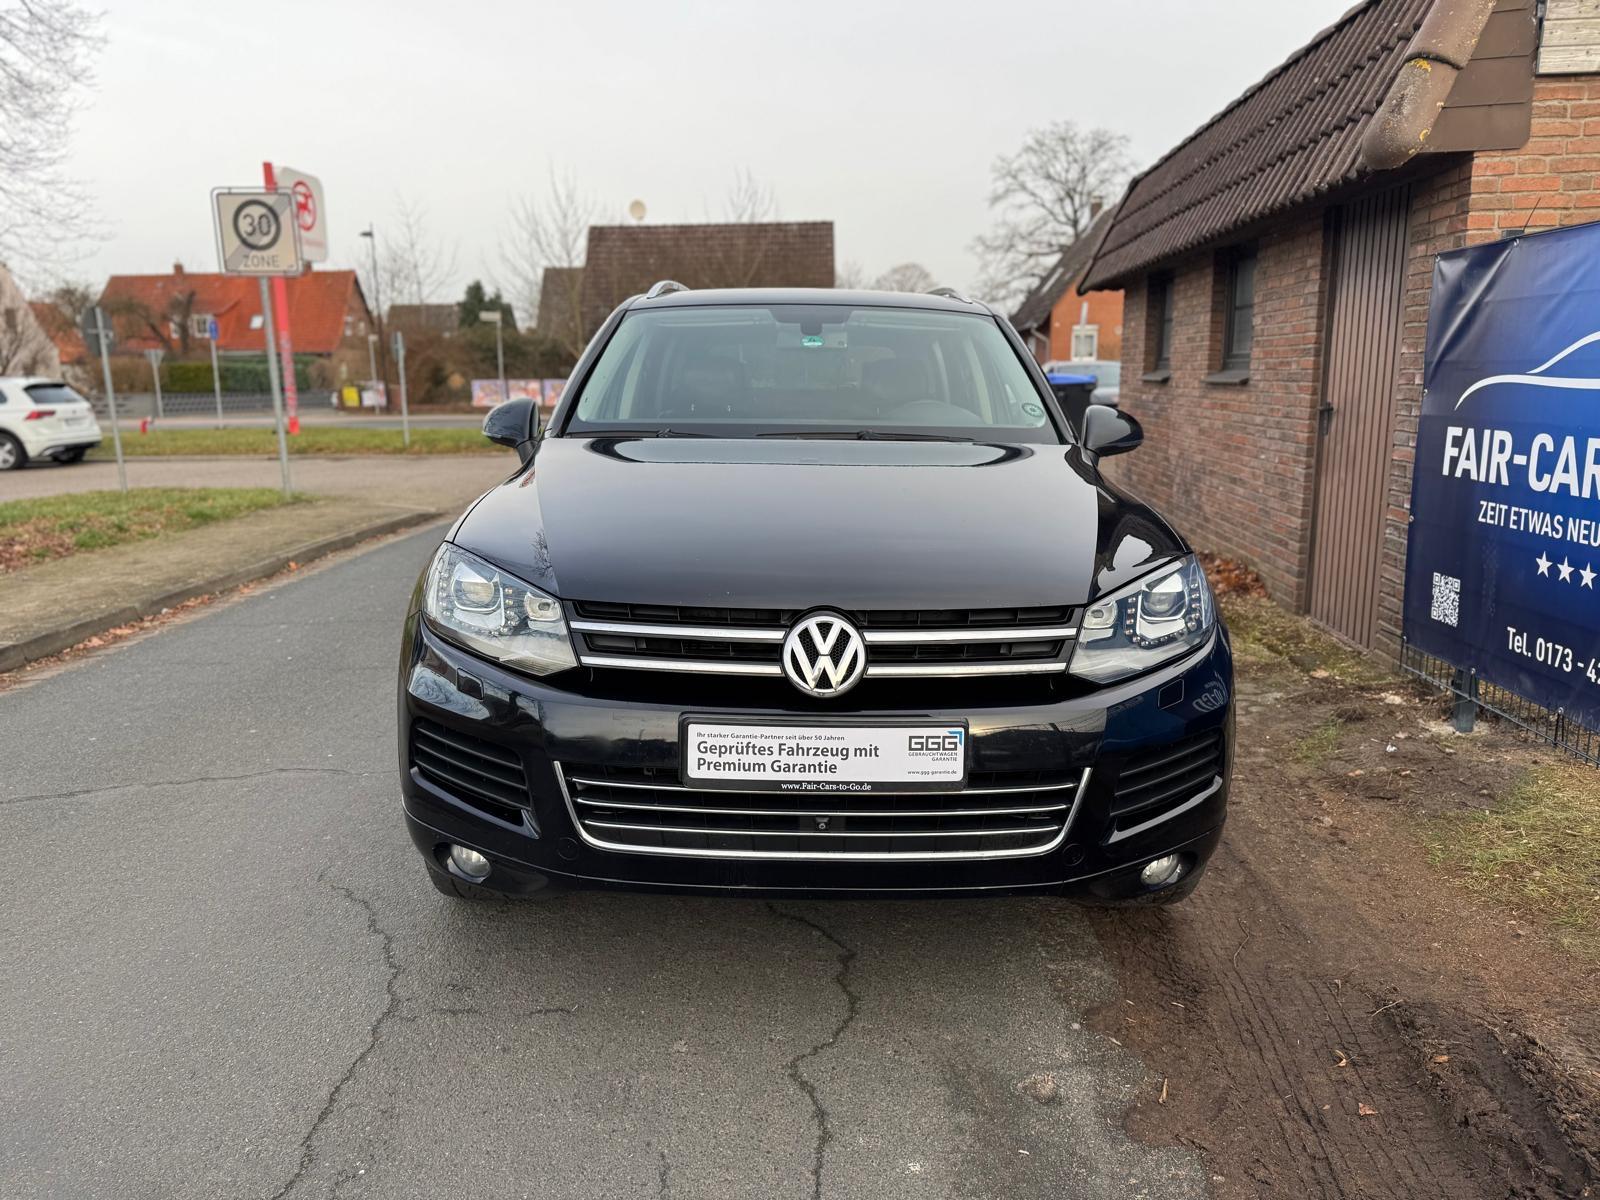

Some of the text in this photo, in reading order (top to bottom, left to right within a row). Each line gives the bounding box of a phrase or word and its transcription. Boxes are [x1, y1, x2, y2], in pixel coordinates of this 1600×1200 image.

[242, 213, 271, 237] 30
[242, 254, 280, 268] ZONE
[1478, 500, 1508, 527] ZEIT
[1509, 506, 1563, 539] ETWAS
[786, 614, 863, 694] VW
[1507, 626, 1532, 657] Tel.
[1536, 637, 1573, 672] 0173
[730, 732, 784, 741] Garantie-Partner
[908, 736, 958, 751] GGG
[697, 741, 880, 760] Geprüftes Fahrzeug mit
[697, 757, 838, 774] Premium Garantie
[781, 782, 872, 791] www.Fair-Cars-to-Go.de
